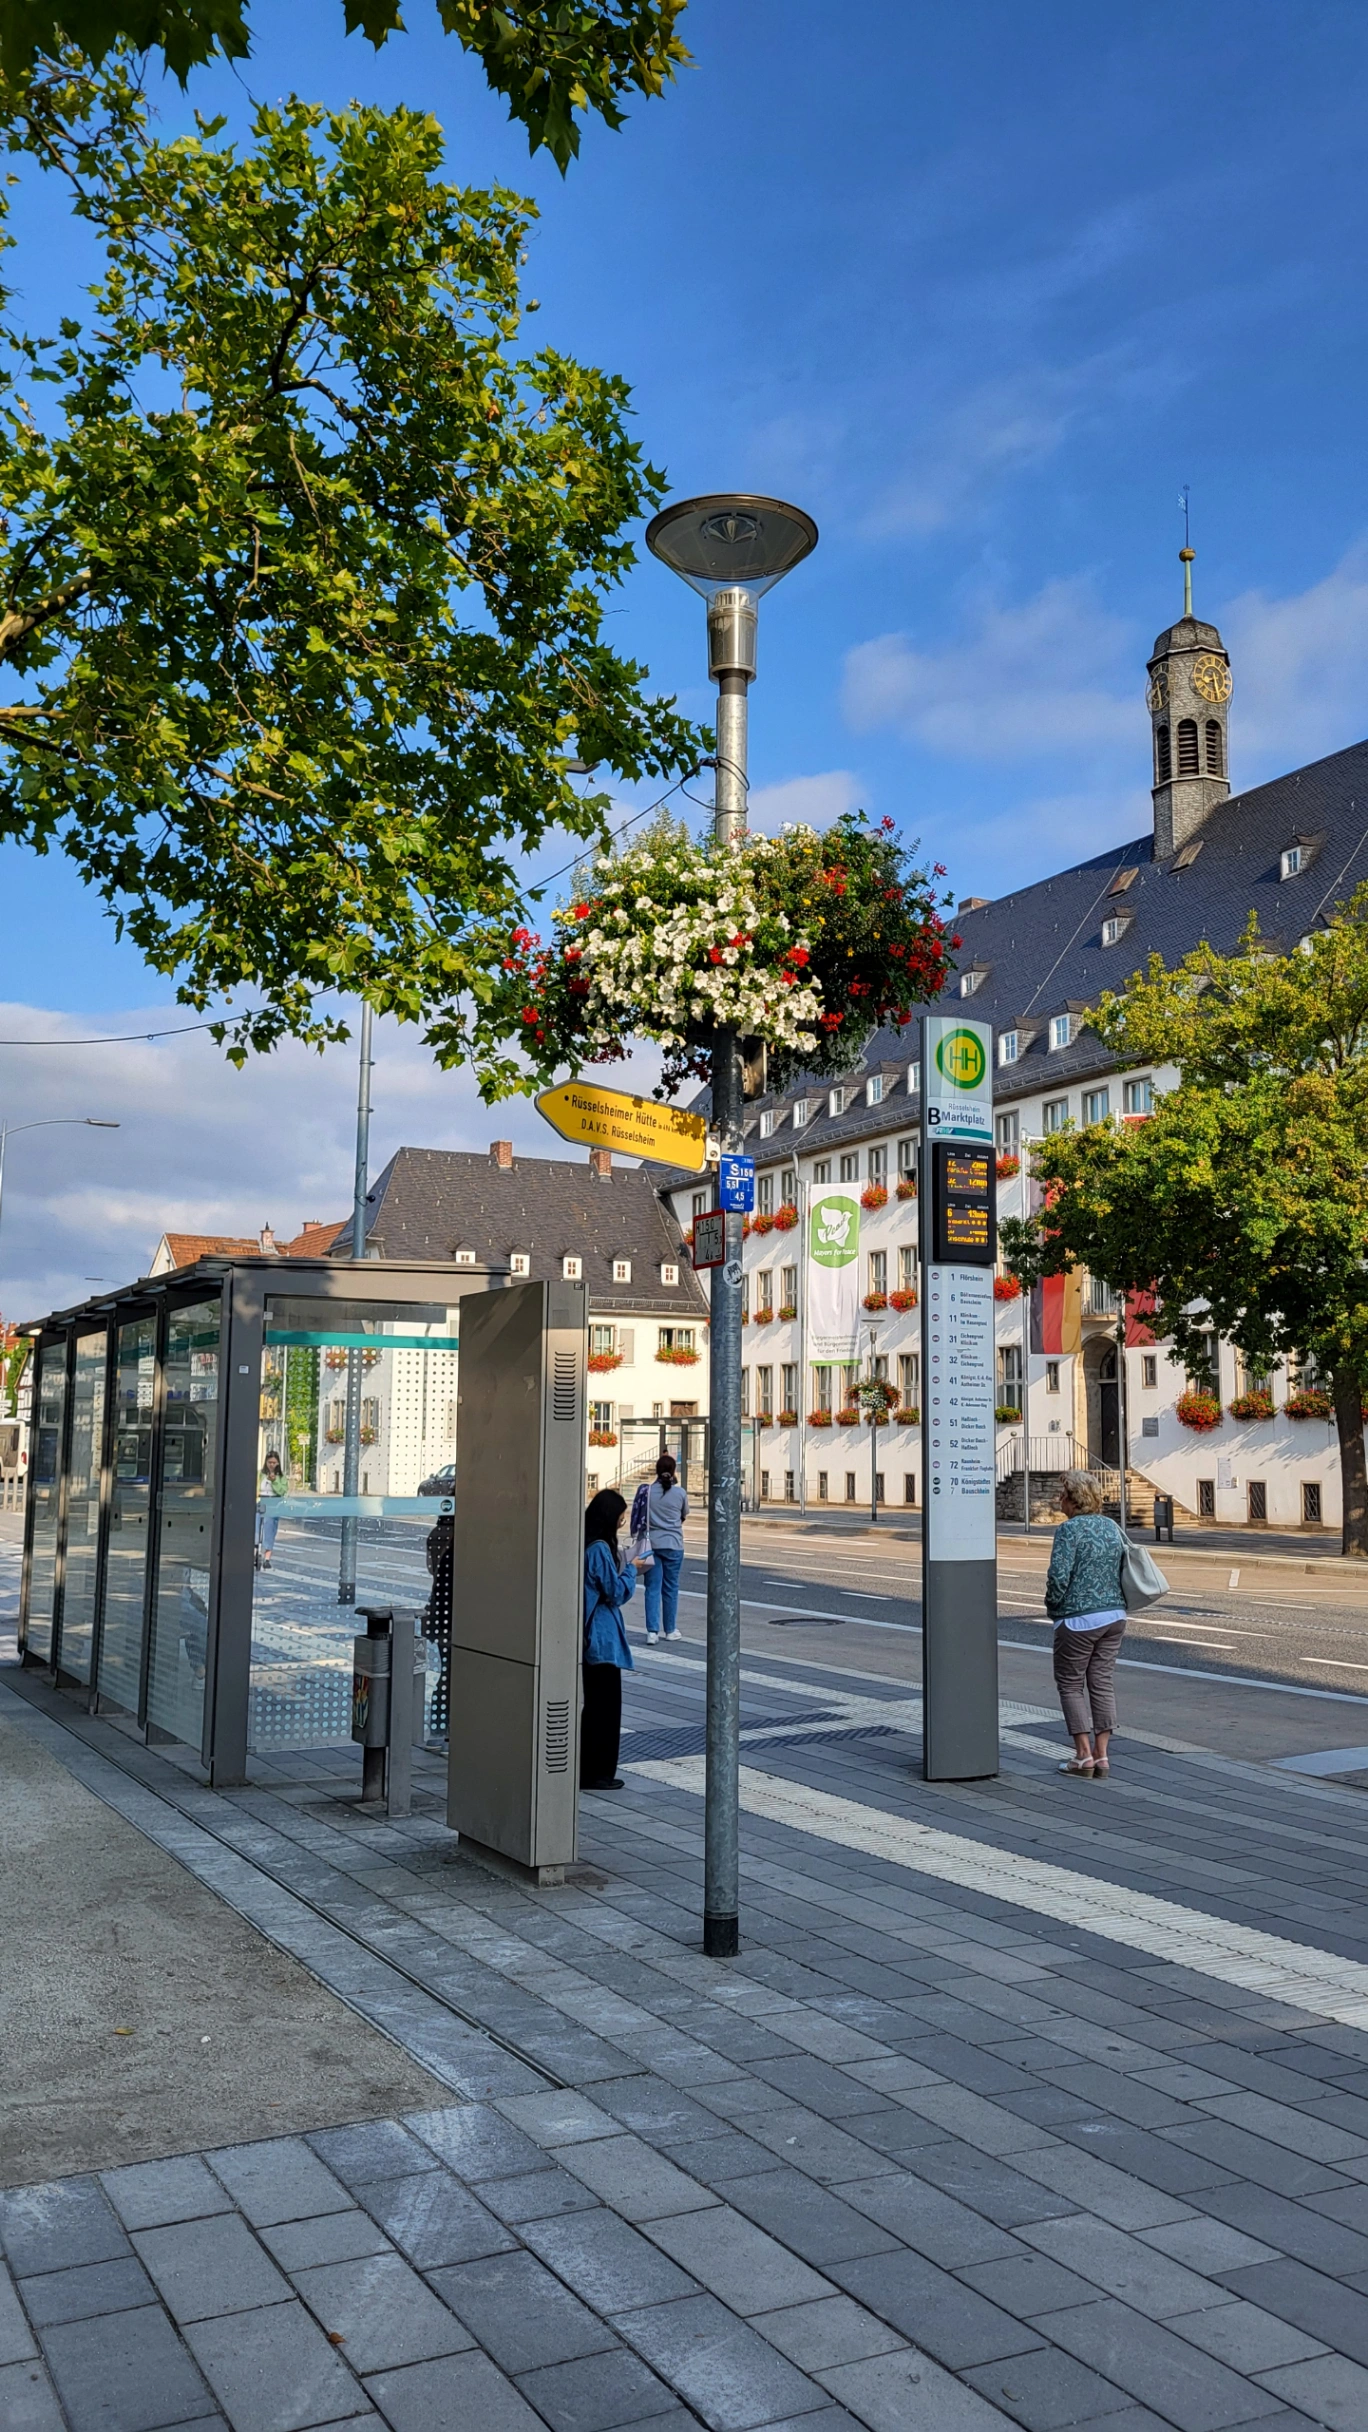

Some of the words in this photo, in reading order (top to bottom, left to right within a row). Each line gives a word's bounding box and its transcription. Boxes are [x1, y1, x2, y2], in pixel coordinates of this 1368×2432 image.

[572, 1094, 633, 1121] Rüsselsheimer
[636, 1110, 657, 1128] Hütte
[948, 1102, 980, 1112] Rüsselsheim
[928, 1106, 941, 1126] B
[941, 1110, 986, 1126] Marktplatz
[581, 1118, 609, 1136] D.A.V.S.
[612, 1126, 656, 1147] Rüsselsheim
[951, 1294, 956, 1302] 6
[950, 1440, 958, 1448] 52
[950, 1461, 958, 1469] 72
